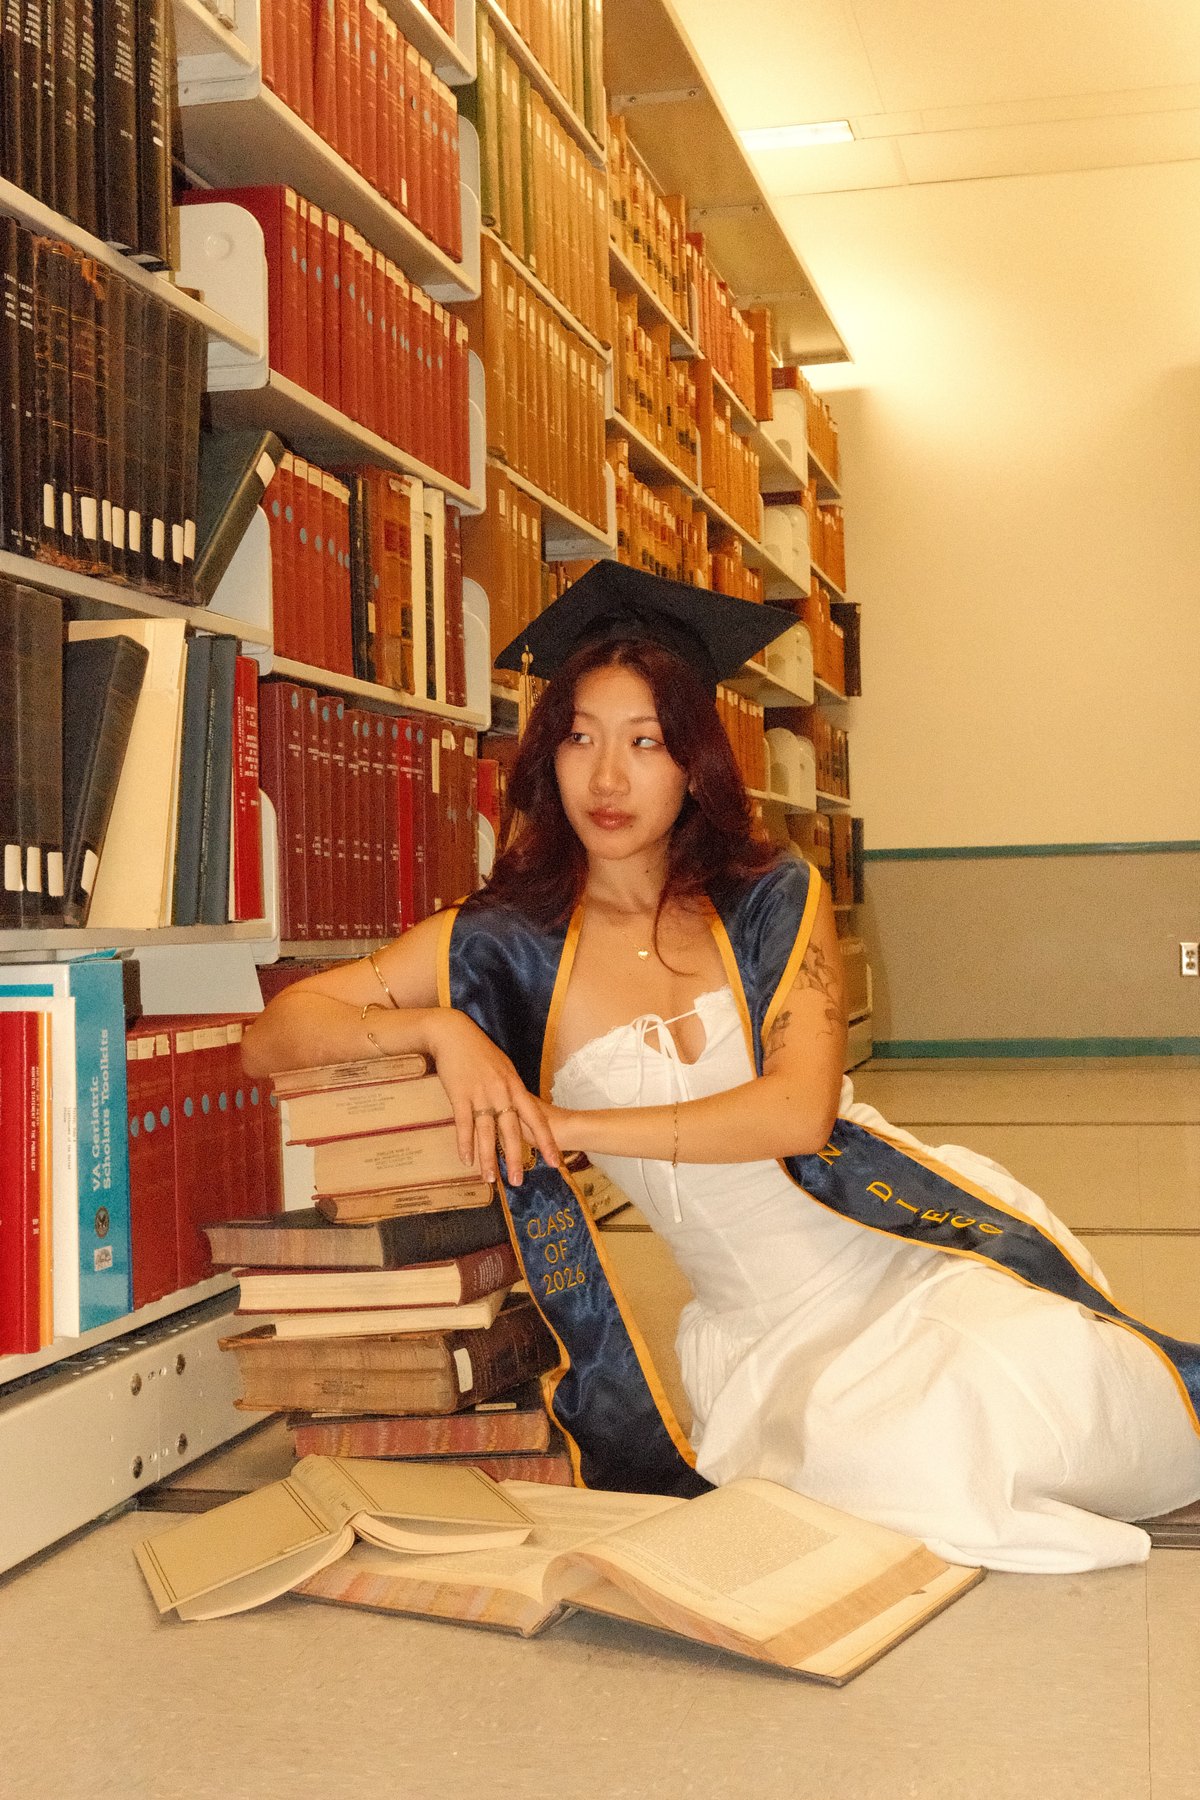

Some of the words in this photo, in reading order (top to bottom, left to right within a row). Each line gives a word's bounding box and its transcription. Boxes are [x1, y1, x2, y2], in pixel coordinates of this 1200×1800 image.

[100, 1028, 110, 1105] Toolkits
[90, 1076, 100, 1158] Geriatric
[102, 1107, 111, 1189] Scholars
[92, 1163, 101, 1191] VA
[527, 1208, 575, 1240] CLASS
[866, 1180, 1004, 1236] DIEGO
[544, 1239, 569, 1264] OF
[543, 1263, 586, 1296] 2026
